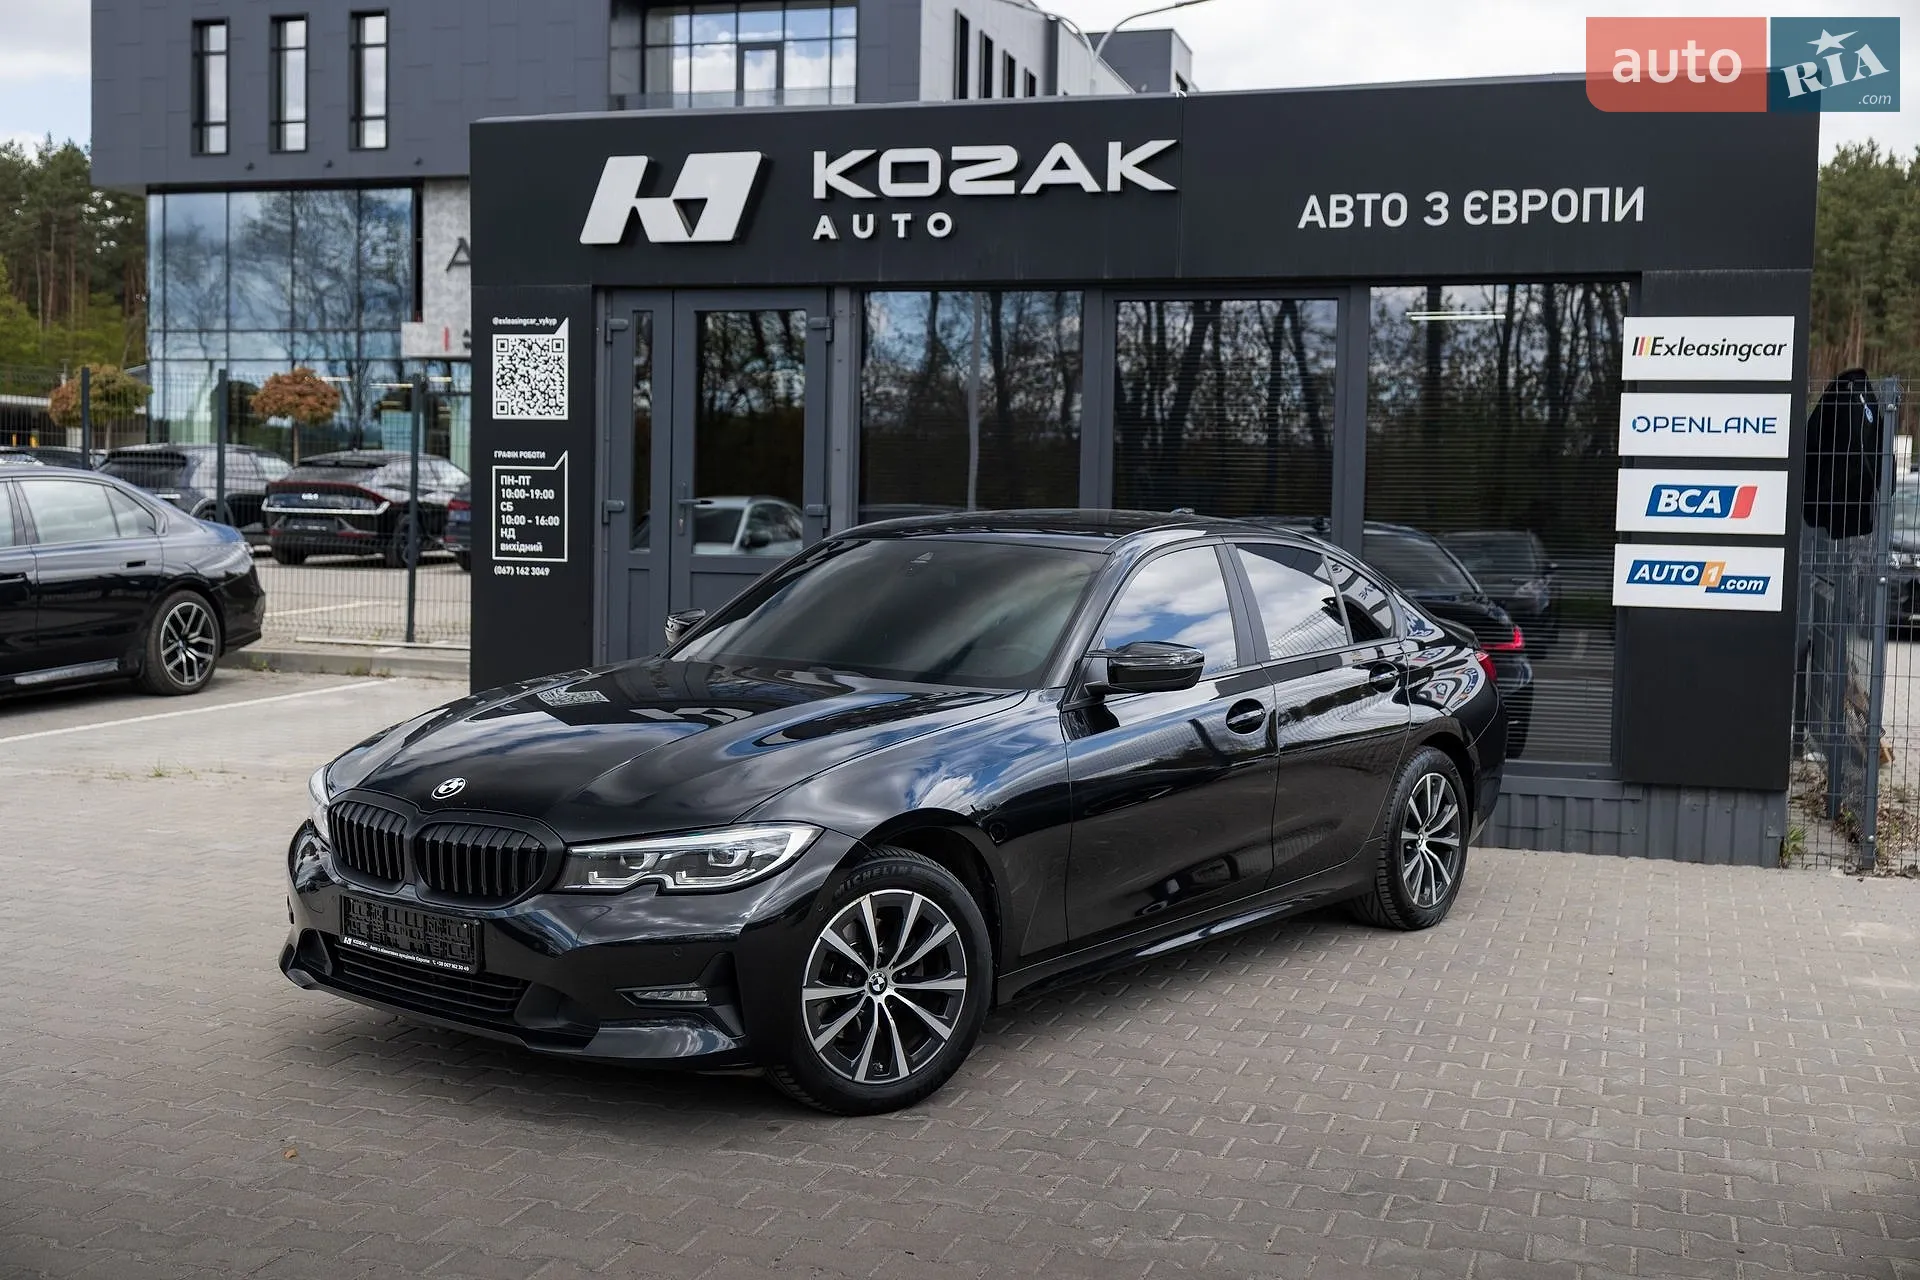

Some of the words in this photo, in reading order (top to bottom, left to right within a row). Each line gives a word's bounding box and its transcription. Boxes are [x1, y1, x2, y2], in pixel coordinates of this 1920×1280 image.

[814, 138, 1178, 199] KOZAK
[1298, 192, 1408, 229] АВТО
[1463, 186, 1645, 226] ЄВРОПИ
[812, 212, 955, 240] AUTO
[1651, 336, 1788, 362] Exleasingcar
[1631, 415, 1778, 434] OPENLANE
[519, 450, 546, 460] РОБОТИ
[500, 475, 532, 486] ПН-ПТ
[501, 487, 555, 500] 10:00-19:00
[500, 501, 514, 512] СБ
[1656, 488, 1723, 514] BCA
[501, 514, 526, 526] 10:00
[534, 515, 560, 526] 16:00
[500, 527, 516, 540] НД
[500, 541, 543, 553] вихідний
[493, 565, 515, 576] (067)
[516, 566, 530, 576] 162
